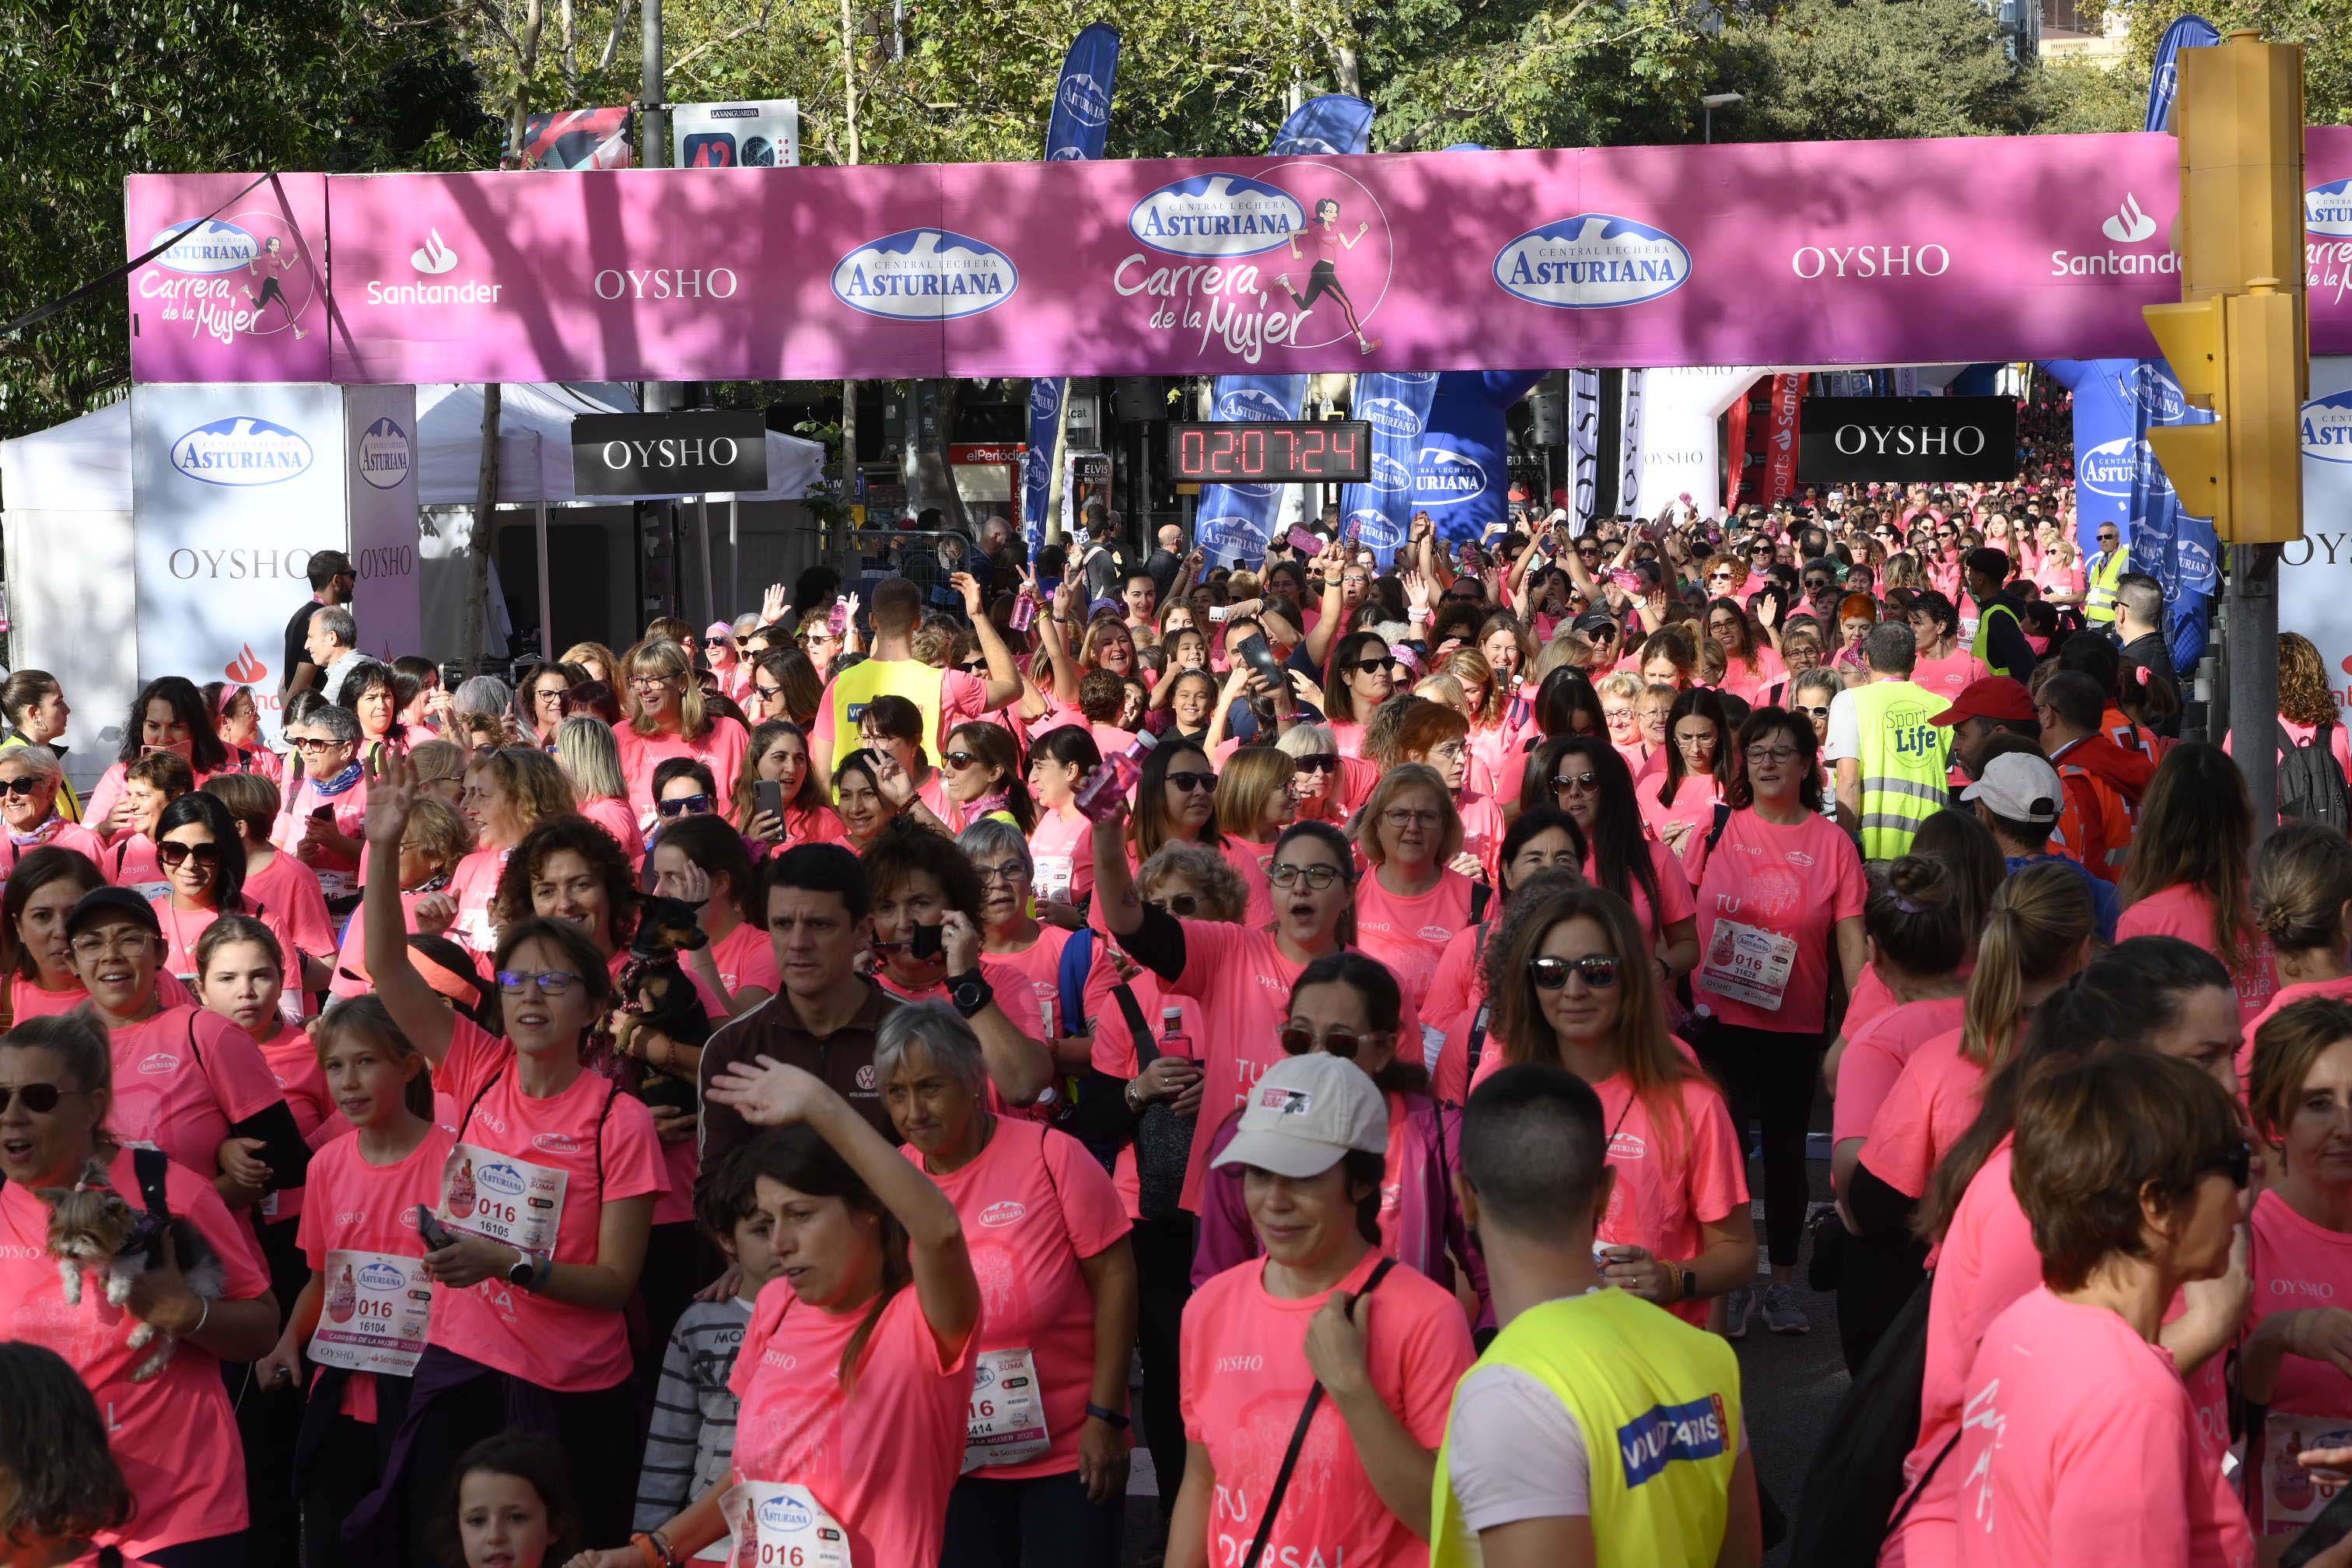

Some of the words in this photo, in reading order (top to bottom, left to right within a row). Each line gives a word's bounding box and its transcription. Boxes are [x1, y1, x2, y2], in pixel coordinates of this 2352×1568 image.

[1169, 202, 1223, 212] CENTRAL
[1229, 201, 1286, 211] LECHERA
[1143, 204, 1290, 236] ASTURIANA
[158, 238, 250, 259] ASTURIANA
[1538, 247, 1600, 257] CENTRAL
[1605, 245, 1670, 255] LECHERA
[874, 260, 933, 269] CENTRAL
[938, 258, 998, 268] LECHERA
[1509, 250, 1675, 285] ASTURIANA
[1792, 244, 1949, 278] OYSHO
[138, 270, 230, 299] Carrera
[594, 268, 737, 299] OYSHO
[845, 263, 1003, 297] ASTURIANA
[1115, 254, 1258, 296] Carrera
[2323, 264, 2338, 286] la
[367, 280, 502, 305] Santander
[162, 302, 178, 320] de
[183, 301, 194, 320] la
[193, 296, 265, 345] Mujer
[1150, 303, 1174, 329] de
[1182, 299, 1201, 329] la
[1198, 292, 1313, 365] Mujer
[1362, 406, 1416, 433] ASTURIANA
[1836, 425, 1985, 456] OYSHO
[182, 443, 303, 468] ASTURIANA
[362, 446, 408, 471] ASTURIANA
[603, 437, 737, 470] OYSHO
[1182, 431, 1355, 474] 02:07:24
[1644, 450, 1703, 465] OYSHO
[1084, 464, 1108, 474] ELVIS
[1202, 529, 1266, 555] ASTURIANA
[2279, 534, 2352, 566] OY
[169, 548, 310, 579] OYSHO
[360, 544, 411, 580] OYSHO
[1886, 709, 1928, 729] Sport
[1895, 726, 1937, 756] Life
[1717, 894, 1741, 914] TU
[1738, 937, 1770, 954] ASTURIANA
[1735, 954, 1762, 971] 016
[1734, 967, 1756, 979] 31628
[1706, 980, 1731, 992] OYSHO
[537, 1136, 577, 1152] ASTURIANA
[1608, 1144, 1643, 1154] STURIANA
[481, 1170, 523, 1192] ASTURIANA
[530, 1181, 555, 1192] SUMA
[478, 1198, 516, 1223] 016
[982, 1210, 1022, 1223] ASTURIANA
[480, 1220, 509, 1238] 16105
[359, 1273, 401, 1286] ASTURIANA
[2270, 1279, 2333, 1299] OYSHO
[359, 1299, 393, 1318] 016
[359, 1321, 386, 1333] 16104
[715, 1330, 745, 1344] MO
[329, 1333, 356, 1342] CARRERA
[377, 1339, 399, 1347] MUJER
[401, 1342, 418, 1350] 2023
[320, 1346, 354, 1360] OYSHO
[999, 1363, 1024, 1372] SUMA
[988, 1435, 1015, 1444] MUJER
[1000, 1447, 1040, 1457] Santander
[1216, 1484, 1248, 1523] TU
[762, 1507, 807, 1524] ASTURIANA
[762, 1543, 803, 1567] 016
